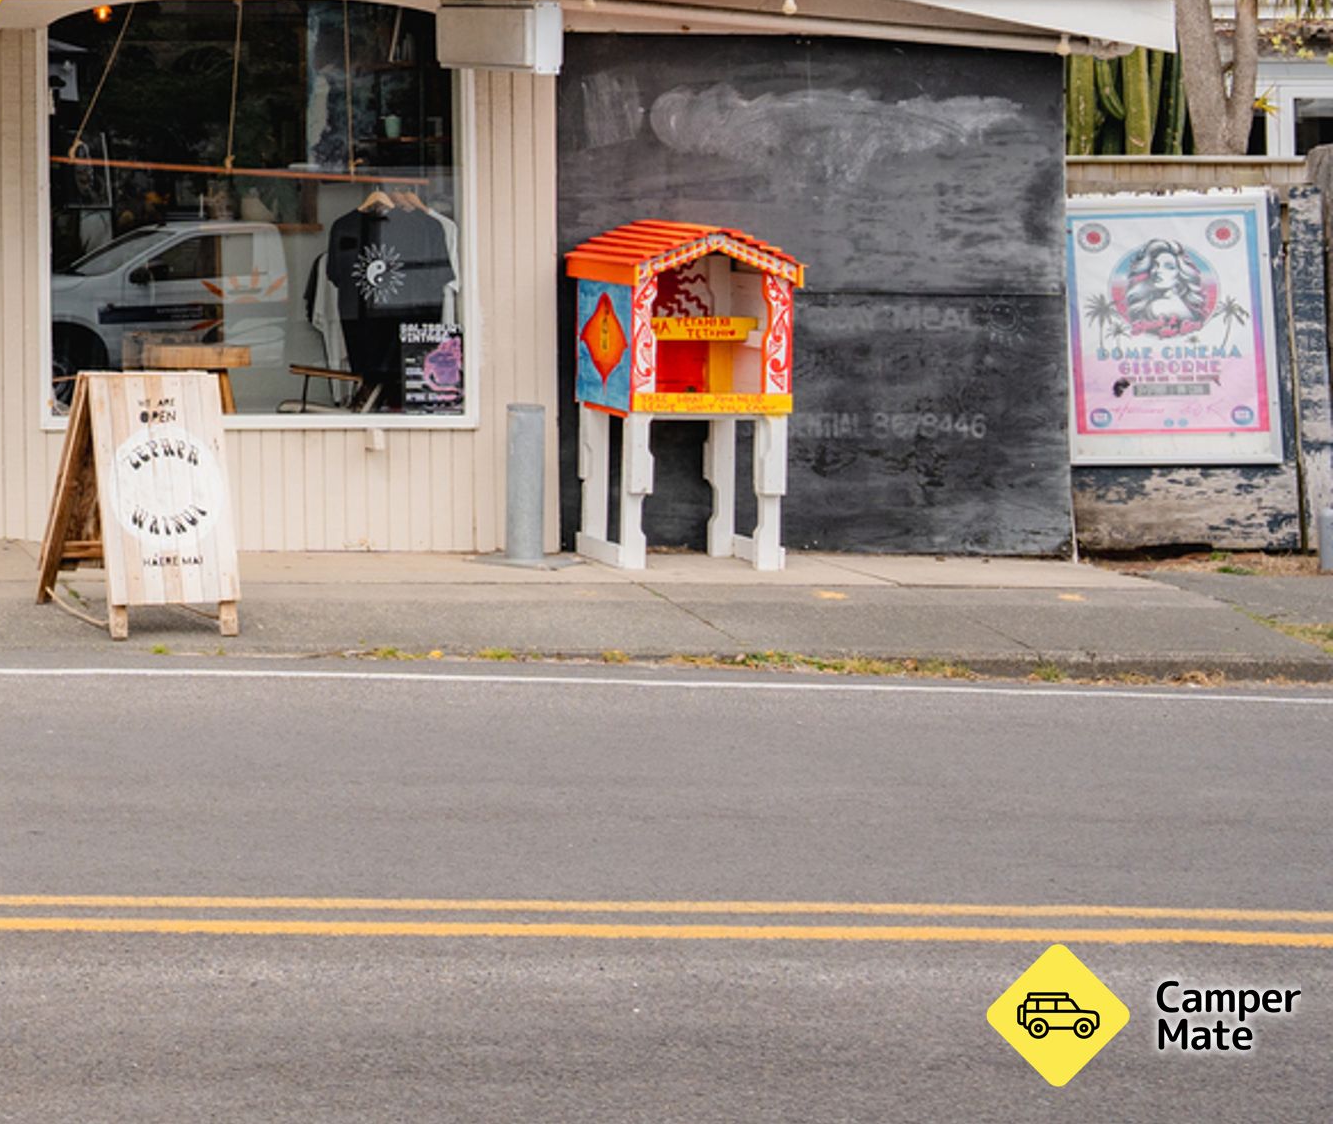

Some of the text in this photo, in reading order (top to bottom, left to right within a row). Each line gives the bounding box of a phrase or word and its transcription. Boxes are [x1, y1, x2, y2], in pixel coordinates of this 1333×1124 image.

[1096, 345, 1242, 361] DOME CINEMA
[1118, 360, 1222, 375] GISBORNE
[139, 410, 177, 423] OPEN
